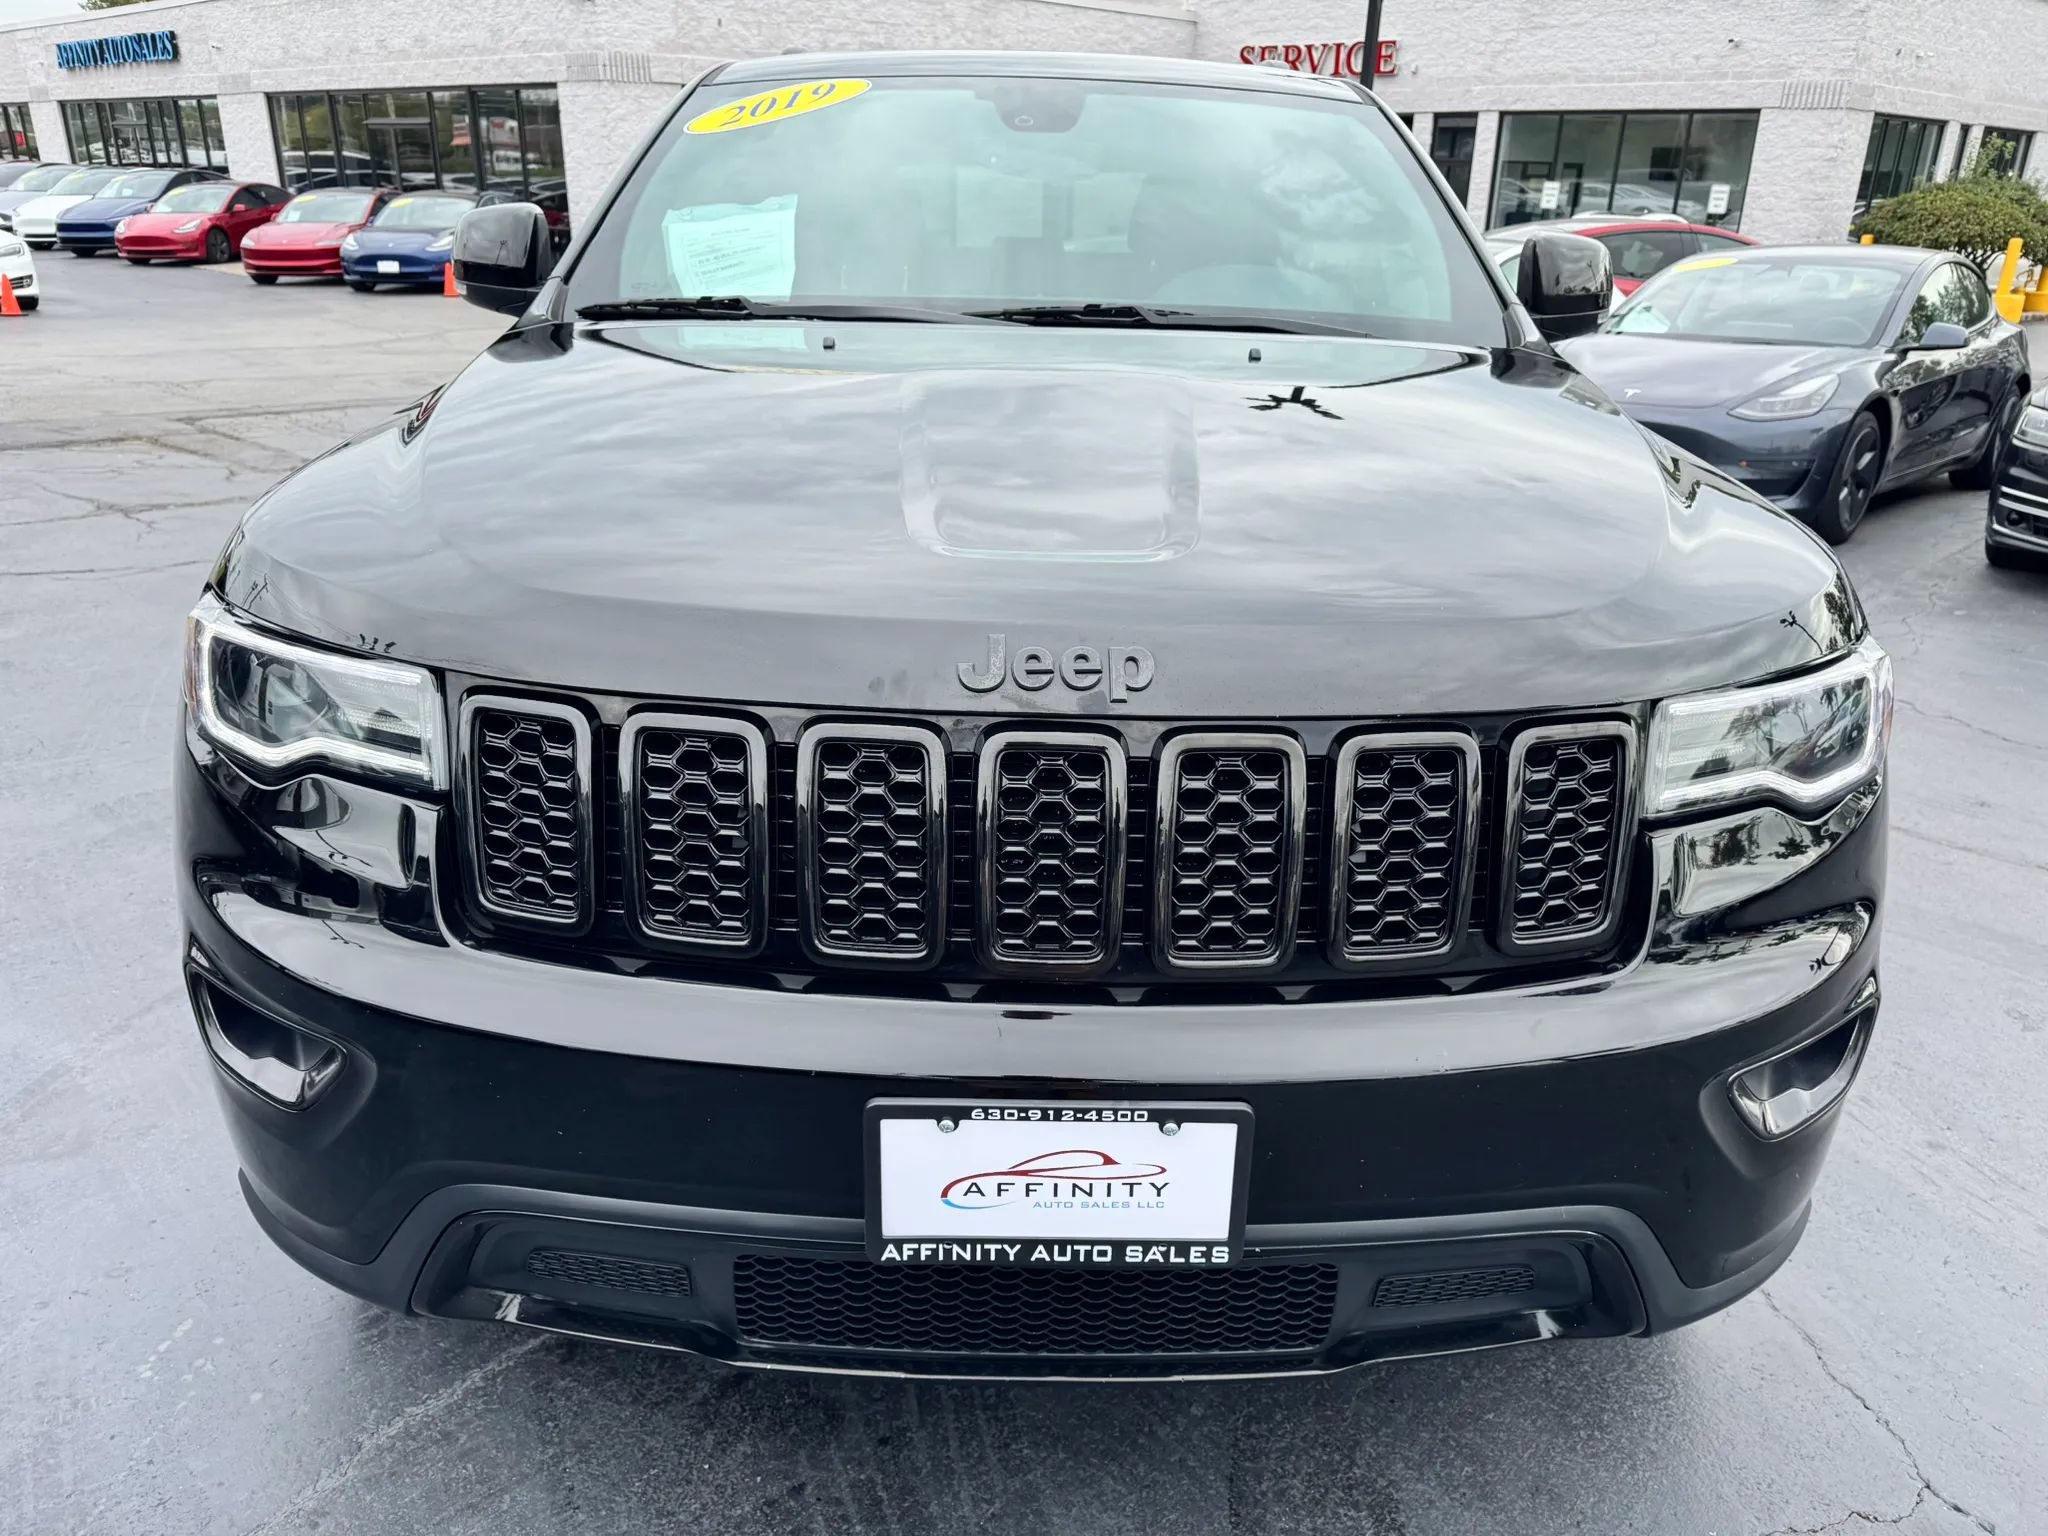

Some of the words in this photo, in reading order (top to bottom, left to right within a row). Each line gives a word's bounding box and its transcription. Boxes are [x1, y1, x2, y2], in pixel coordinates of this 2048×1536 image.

[56, 38, 102, 70] AFFINITY
[102, 33, 134, 66] AUTO
[132, 30, 176, 63] SALES
[719, 82, 837, 128] 2019
[957, 633, 1155, 704] Jeep
[970, 1108, 1149, 1122] 630-912-4500
[962, 1182, 1170, 1198] AFFINITY
[1032, 1200, 1074, 1209] AUTO
[1080, 1200, 1131, 1209] SALES
[1137, 1200, 1165, 1209] LLC
[880, 1243, 1022, 1263] AFFINITY
[1030, 1244, 1113, 1263] AUTO
[1125, 1244, 1230, 1264] SALES
